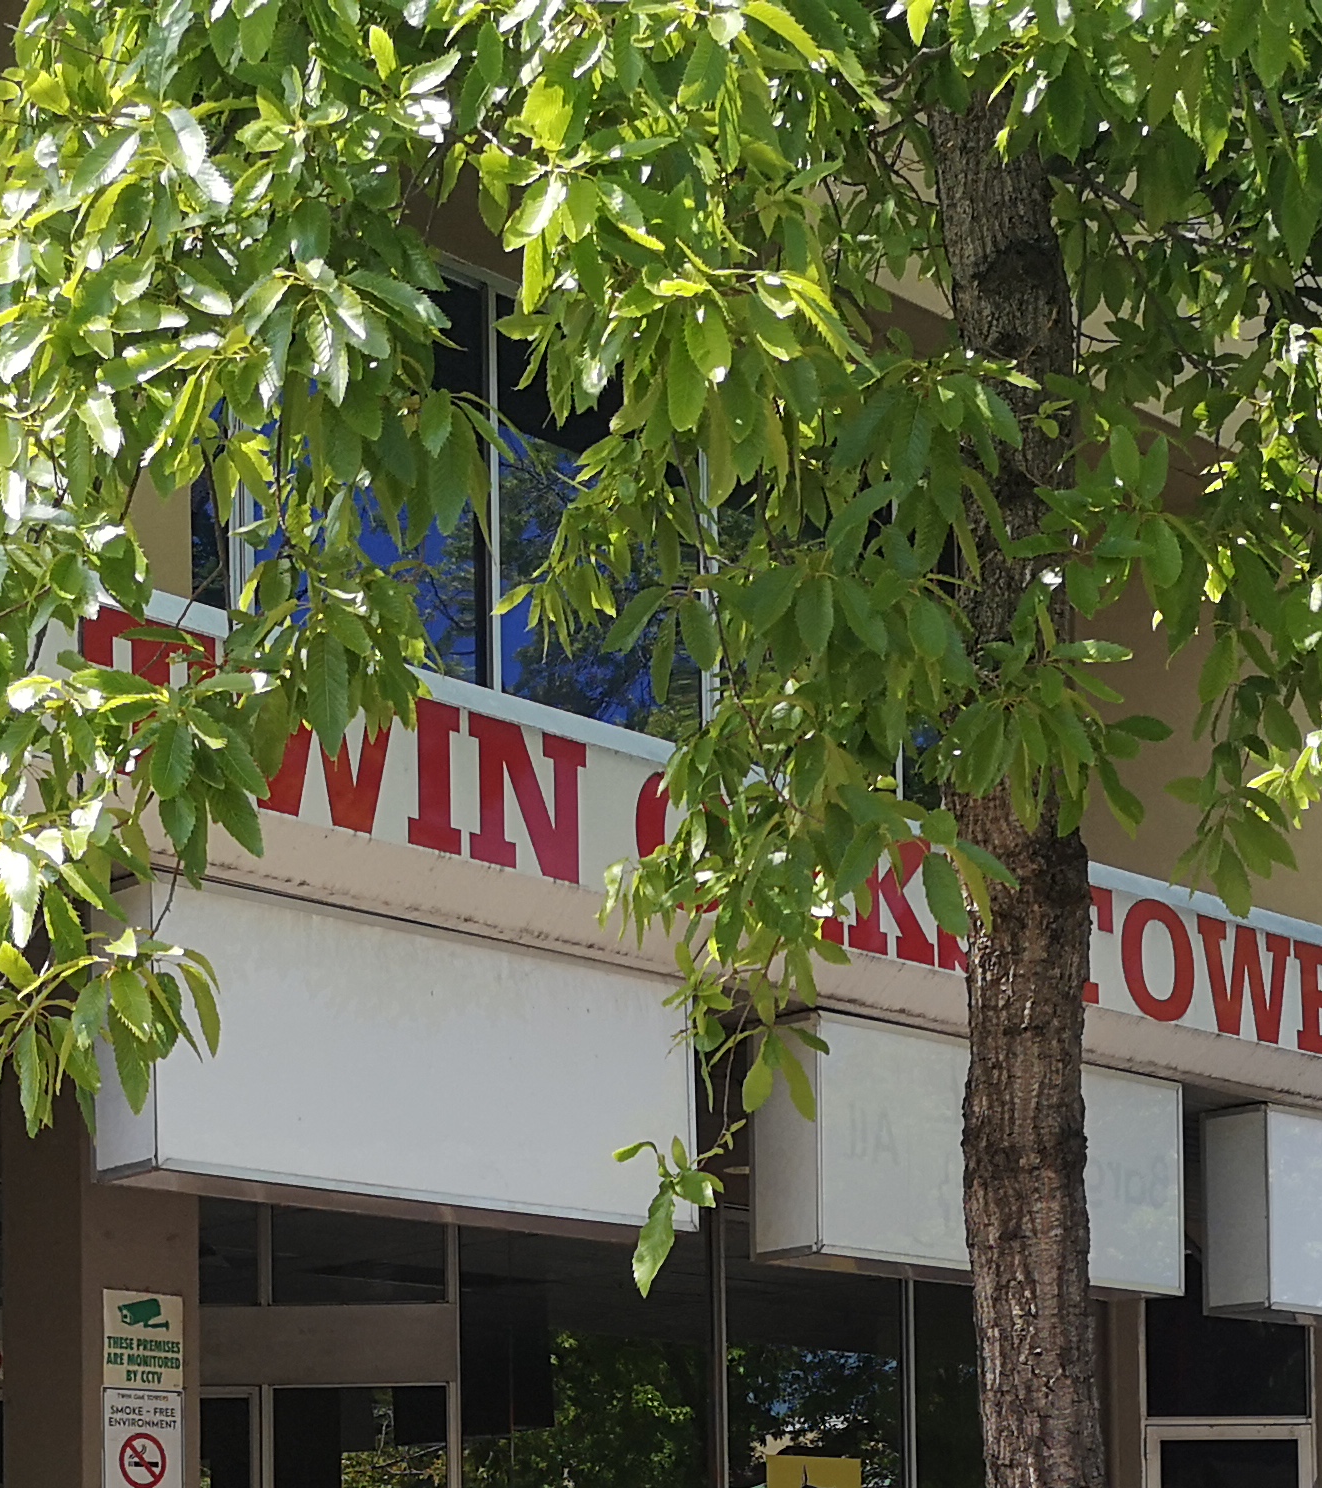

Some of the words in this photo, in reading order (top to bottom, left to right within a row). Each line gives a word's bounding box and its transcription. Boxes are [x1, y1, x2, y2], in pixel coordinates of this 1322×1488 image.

[107, 1335, 134, 1351] THESE
[137, 1338, 181, 1355] PREMISES
[106, 1352, 125, 1366] ARE
[127, 1354, 181, 1370] MONITORED
[126, 1370, 138, 1383] BY
[141, 1370, 163, 1385] CCTV
[110, 1404, 143, 1416] SMOKE
[153, 1407, 176, 1417] FREE
[108, 1416, 177, 1430] ENVIRONMENT
